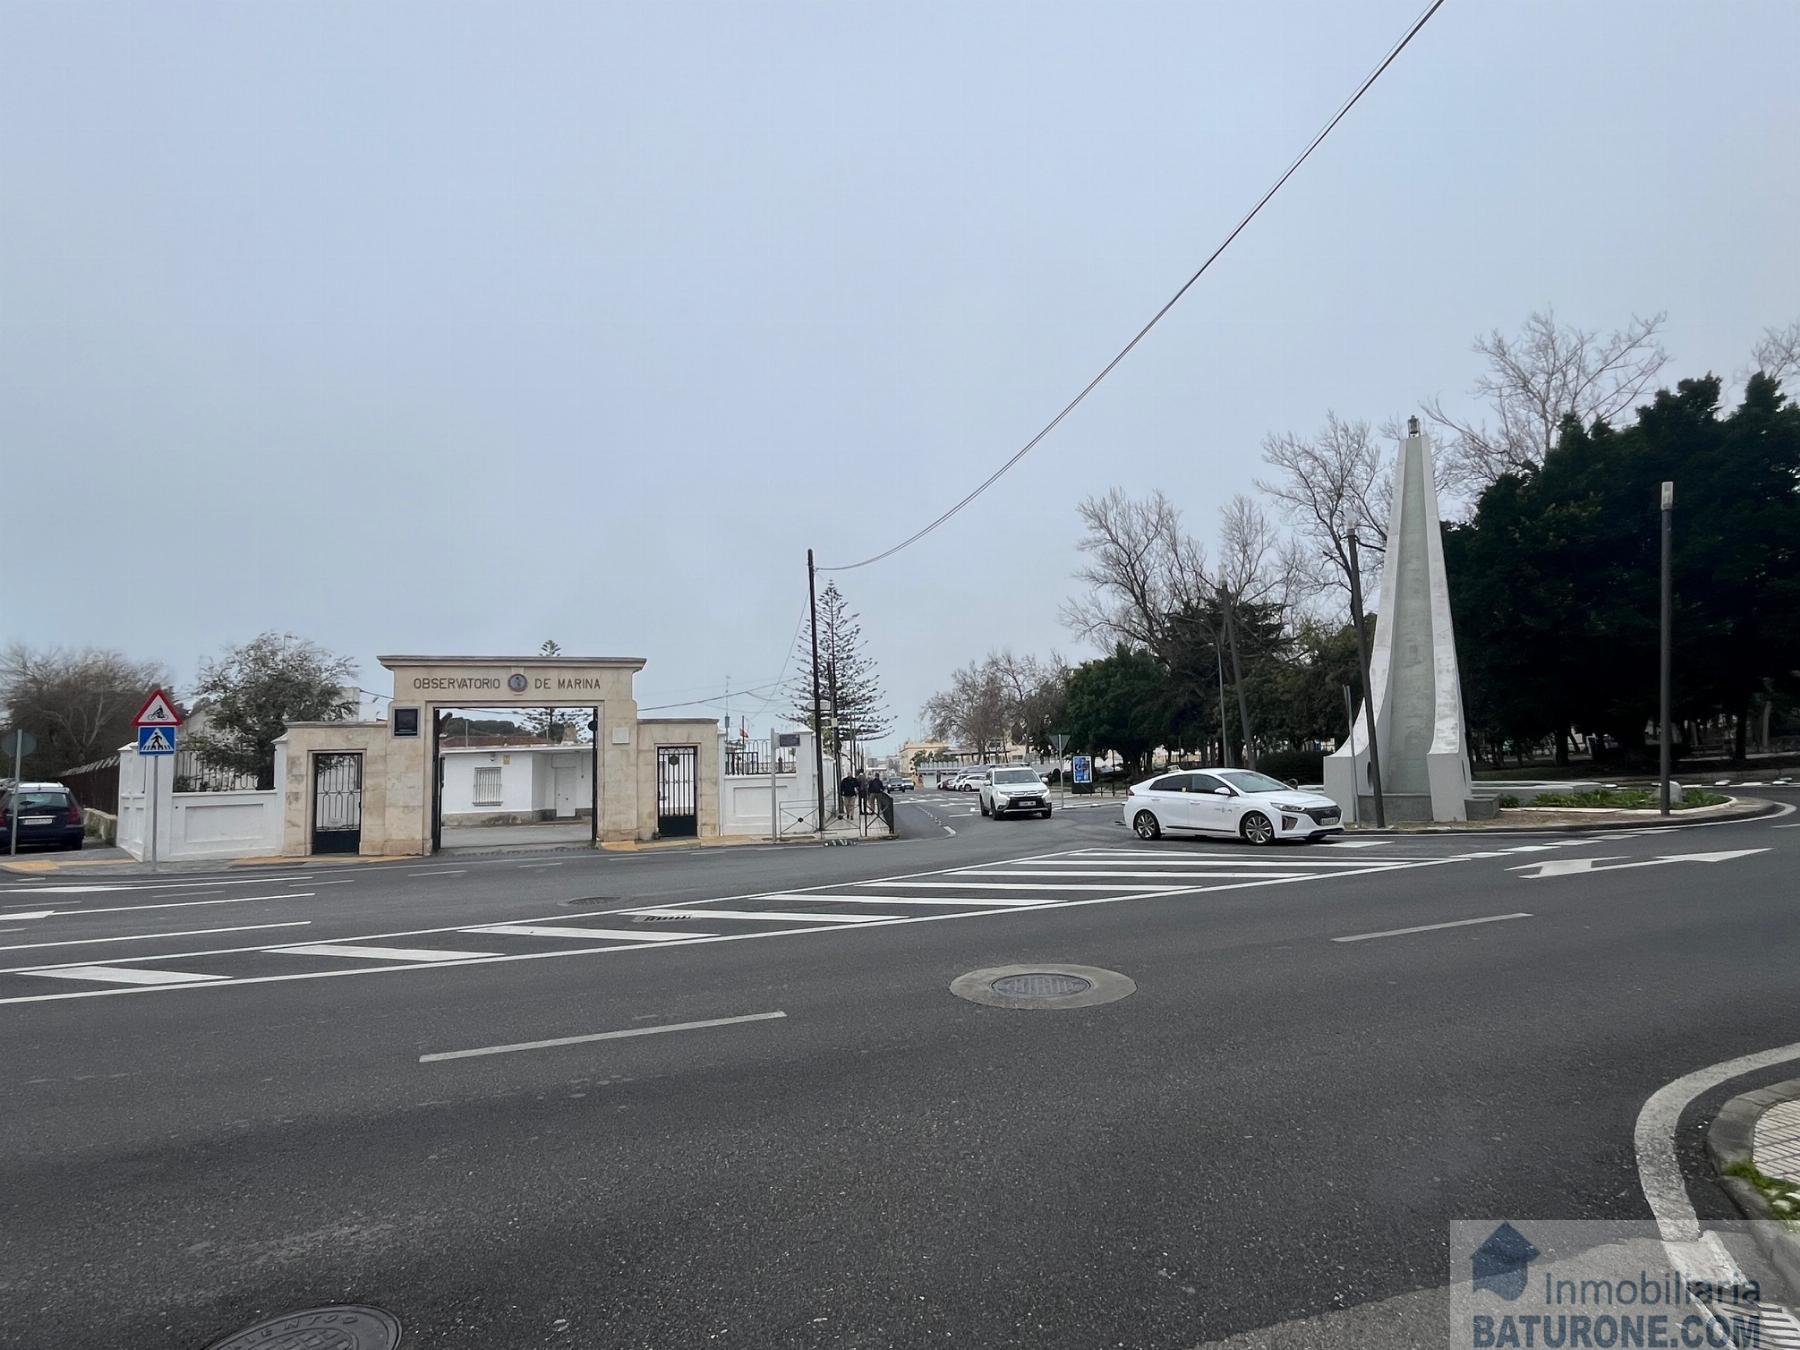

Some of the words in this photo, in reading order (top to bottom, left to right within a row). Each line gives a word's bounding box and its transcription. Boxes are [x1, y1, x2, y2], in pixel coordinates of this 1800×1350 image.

[413, 677, 501, 690] OBSERVATORIO
[534, 678, 552, 690] DE
[558, 677, 601, 690] MARINA
